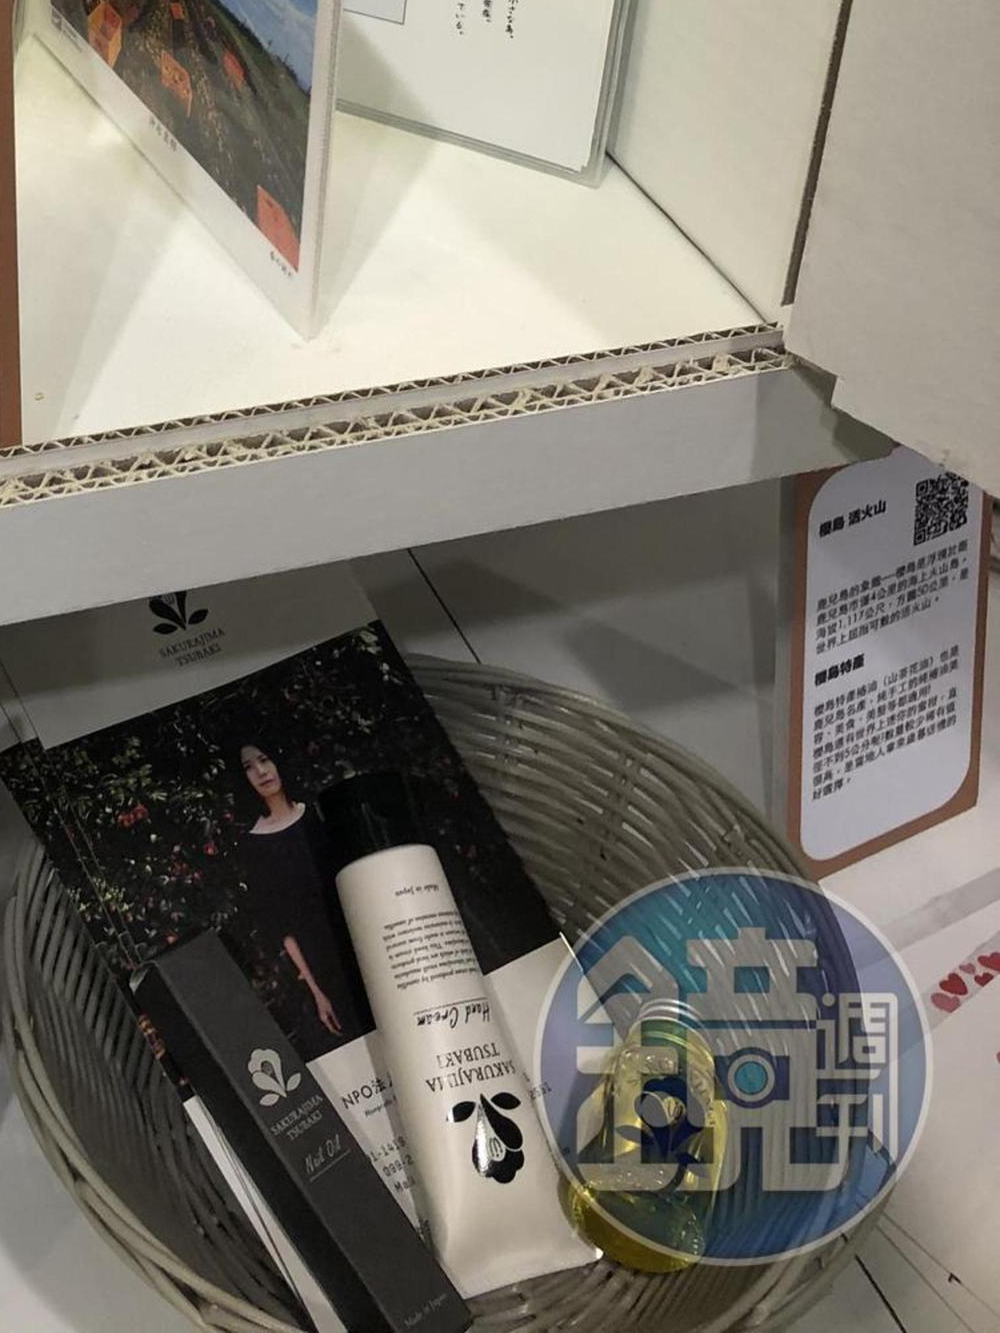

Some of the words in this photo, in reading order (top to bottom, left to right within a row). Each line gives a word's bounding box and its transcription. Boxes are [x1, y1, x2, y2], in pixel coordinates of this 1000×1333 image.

[848, 499, 887, 528] 活火山
[416, 1006, 459, 1029] Cream
[465, 1001, 491, 1024] Hand
